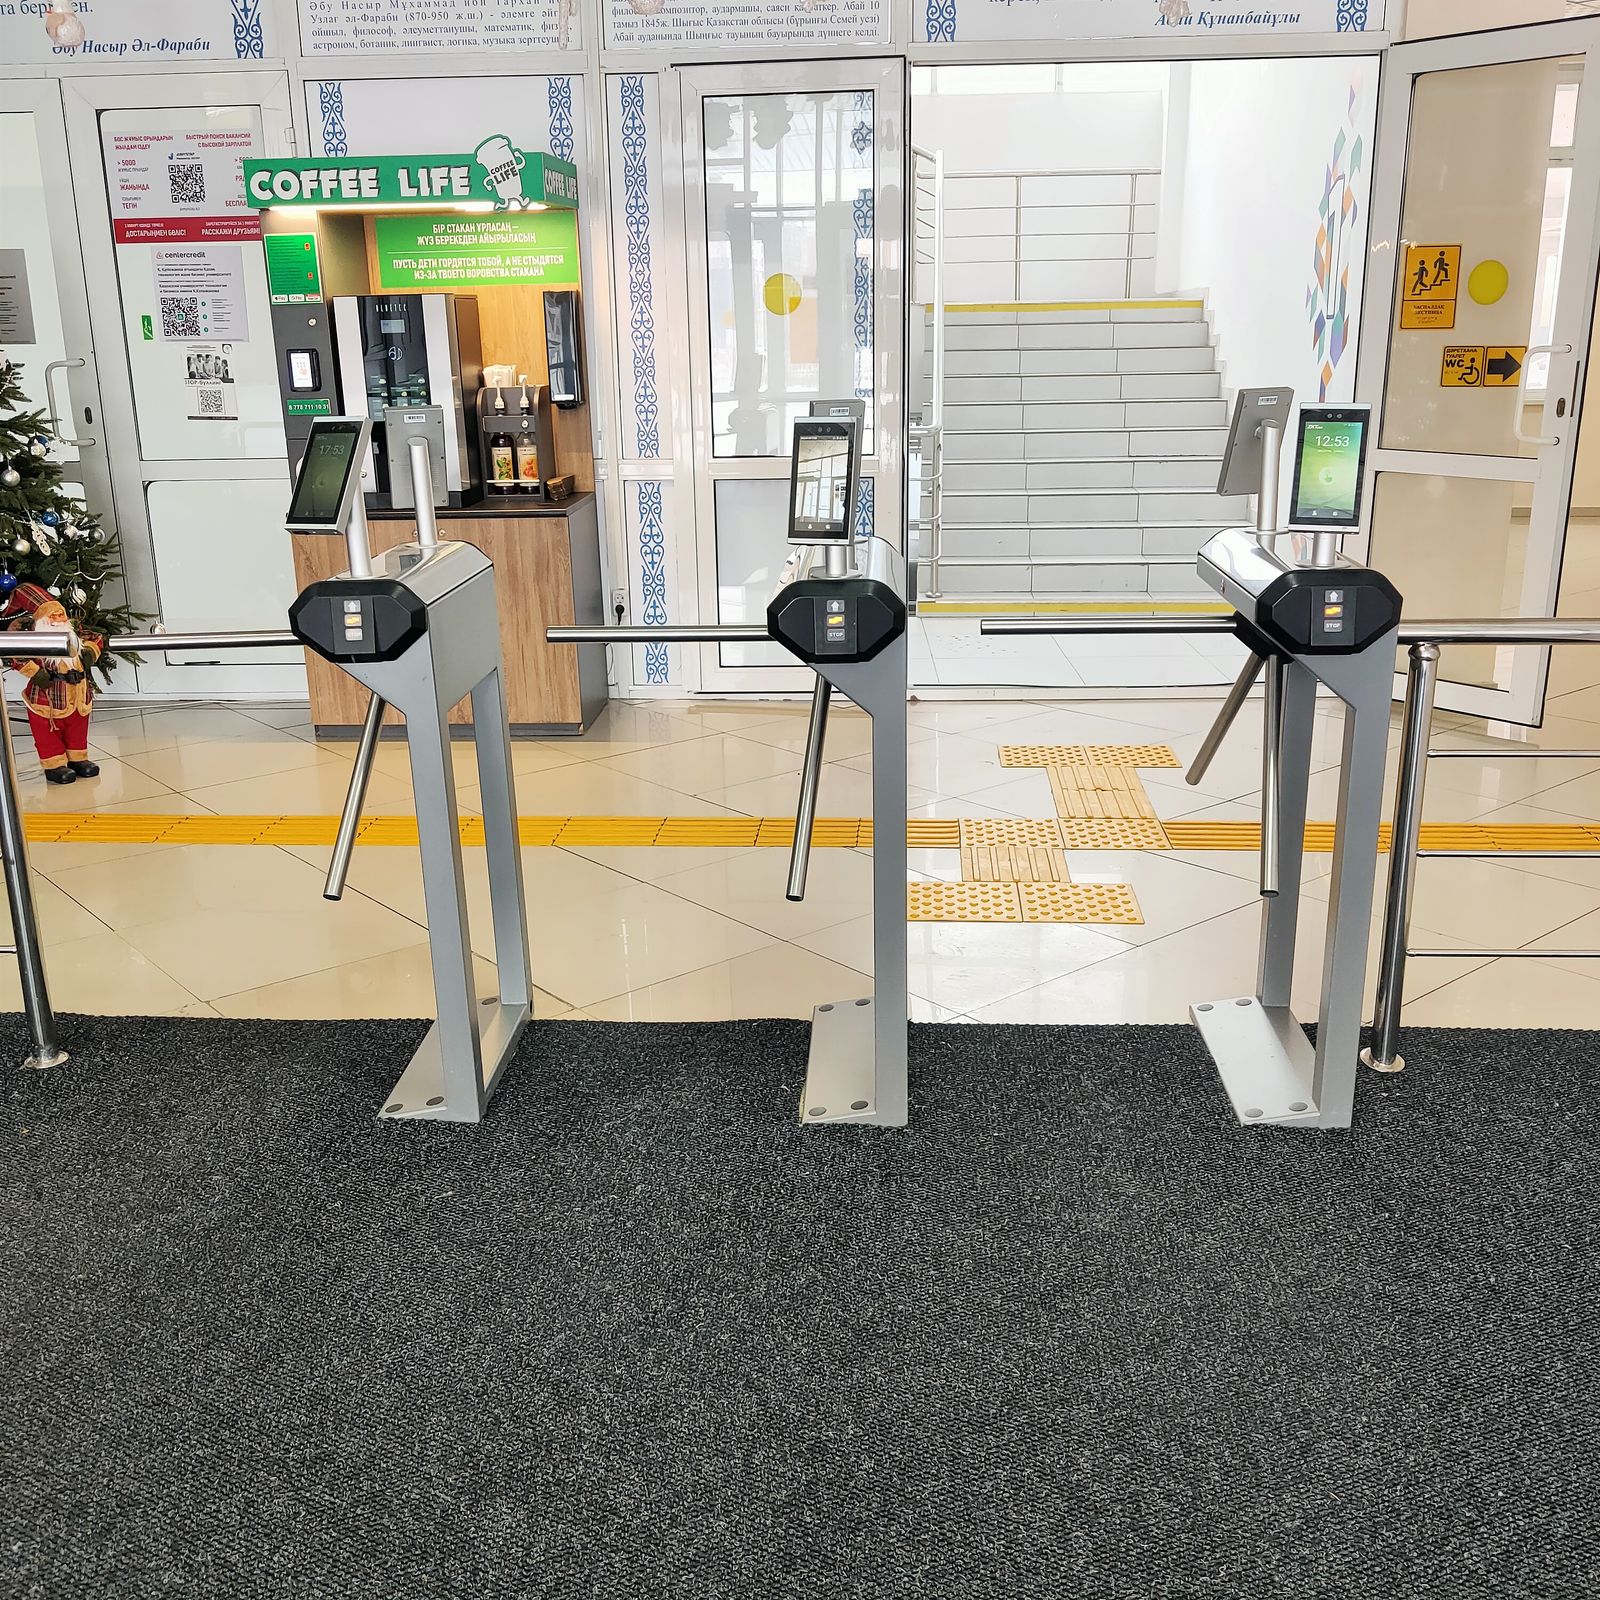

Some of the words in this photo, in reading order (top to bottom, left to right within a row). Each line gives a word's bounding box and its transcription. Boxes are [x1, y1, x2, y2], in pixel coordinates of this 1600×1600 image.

[310, 1, 333, 13] Әбу
[341, 1, 382, 12] Насыр
[389, 0, 456, 11] Мұхаммад
[657, 6, 708, 17] омпозитор,
[711, 5, 763, 16] аудармашы,
[766, 4, 790, 13] саяси
[794, 4, 839, 14] қааткер.
[843, 1, 865, 11] Абай
[870, 1, 880, 10] 10
[310, 14, 338, 24] Узлаг
[345, 13, 399, 24] әл-Фараби
[405, 11, 449, 24] (870-950
[456, 10, 484, 21] ж.ш.)
[500, 10, 535, 19] әлемге
[612, 20, 638, 29] тамыз
[641, 18, 670, 28] 1845ж.
[672, 18, 704, 28] Шығыс
[706, 17, 749, 28] Қазақстан
[751, 16, 784, 26] облысы
[786, 15, 828, 27] (бұрынғы
[830, 14, 858, 24] Семей
[860, 14, 880, 26] уезі)
[1197, 11, 1301, 28] Құнанбайұлы
[311, 27, 347, 38] ойшыл,
[352, 25, 397, 38] философ,
[484, 24, 535, 34] математик,
[541, 21, 573, 33] физ,
[612, 32, 635, 42] Абай
[637, 33, 683, 44] ауданында
[767, 28, 815, 41] бауырында
[817, 28, 852, 40] дүниеге
[855, 27, 880, 37] келді.
[82, 39, 128, 56] Насыр
[131, 38, 210, 55] Әл-Фараби
[312, 40, 358, 51] астроном,
[360, 39, 400, 50] ботаник,
[401, 39, 445, 49] лингвист,
[446, 38, 480, 48] логика,
[482, 38, 516, 48] музыка
[489, 159, 516, 176] COFFEE
[249, 167, 380, 201] COFFEE
[397, 165, 471, 199] LIFE
[493, 167, 521, 185] LIFE
[544, 168, 565, 197] COFFEE
[565, 176, 578, 201] LIFE
[201, 228, 232, 236] РАССКАЖИ
[433, 224, 446, 234] БІР
[447, 223, 475, 234] СТАКАН
[476, 222, 512, 234] ҰРЛАСАҢ
[416, 236, 434, 246] ЖҮЗ
[435, 235, 478, 246] БЕРЕКЕДЕН
[479, 232, 537, 245] АЙЫРЫЛАСЫҢ
[164, 250, 206, 259] centercredit
[392, 259, 417, 270] ПУСТЬ
[418, 258, 438, 270] ДЕТИ
[438, 257, 477, 269] ГОРДЯТСЯ
[477, 255, 504, 268] ТОБОЙ,
[512, 256, 523, 266] НЕ
[523, 254, 564, 266] СТЫДЯТСЯ
[414, 270, 437, 280] ИЗ-ЗА
[438, 269, 466, 279] ТВОЕГО
[466, 268, 510, 279] ВОРОВСТВА
[511, 267, 544, 278] СТАКАНА
[1445, 359, 1465, 369] WC
[1315, 435, 1350, 448] 12:53
[319, 444, 345, 456] 17:53
